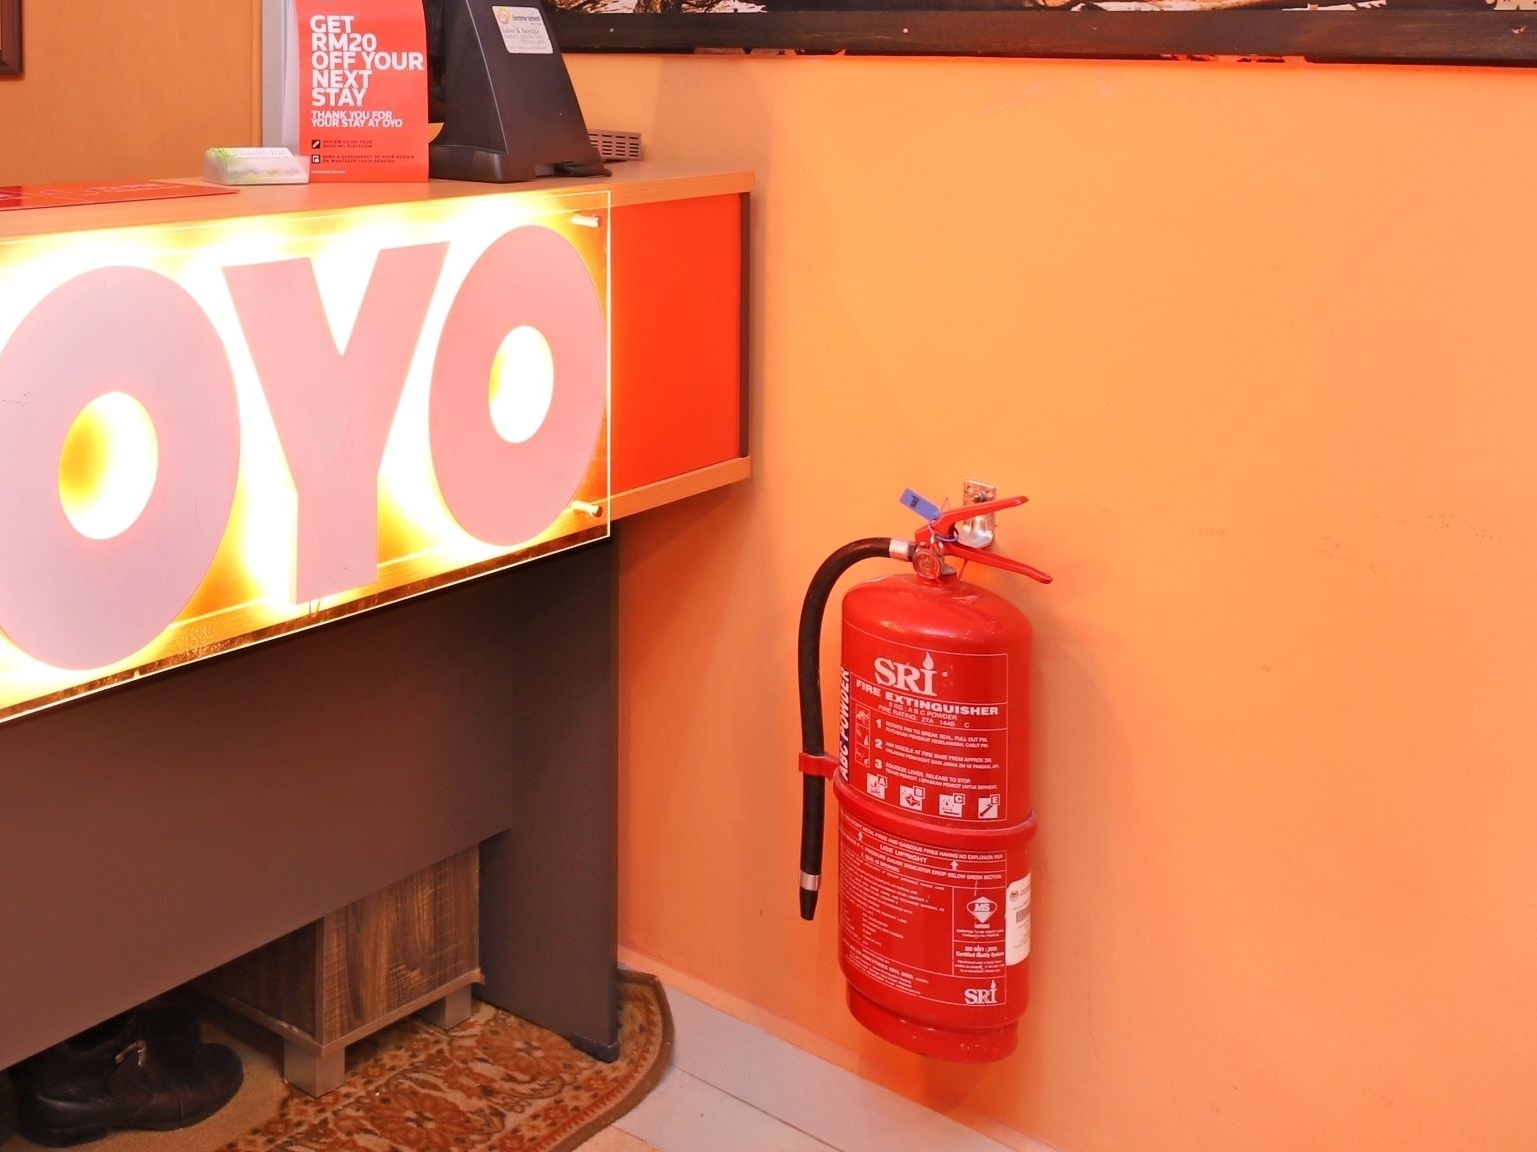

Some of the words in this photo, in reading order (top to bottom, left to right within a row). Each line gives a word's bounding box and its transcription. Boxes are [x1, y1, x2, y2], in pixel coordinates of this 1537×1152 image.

[310, 14, 354, 33] GET
[311, 32, 377, 52] RM20
[312, 51, 356, 70] OFF
[360, 51, 424, 71] YOUR
[312, 69, 373, 88] NEXT
[312, 87, 367, 107] STAY
[312, 110, 347, 119] THANK
[349, 110, 369, 119] YOU
[372, 111, 393, 120] FOR
[312, 118, 339, 127] YOUR
[342, 119, 366, 128] STAY
[368, 119, 382, 128] AT
[382, 119, 403, 128] OYO
[874, 652, 937, 696] SRI
[840, 666, 850, 742] POWDER
[856, 679, 881, 697] FIRE
[885, 691, 998, 715] EXTINGUISHER
[876, 719, 882, 729] 1
[878, 705, 892, 714] FIRE
[921, 716, 934, 724] 27A
[939, 718, 955, 727] 144B
[920, 708, 926, 716] C
[927, 710, 957, 721] POWDER
[874, 738, 883, 749] 2
[839, 741, 849, 783] ABC
[874, 758, 883, 769] 3
[925, 772, 949, 782] RELEASE
[956, 795, 963, 803] C
[879, 843, 894, 854] USE
[894, 849, 928, 863] UPRIGHT
[931, 869, 947, 877] DROP
[974, 903, 991, 912] MS
[964, 980, 998, 1005] SRI
